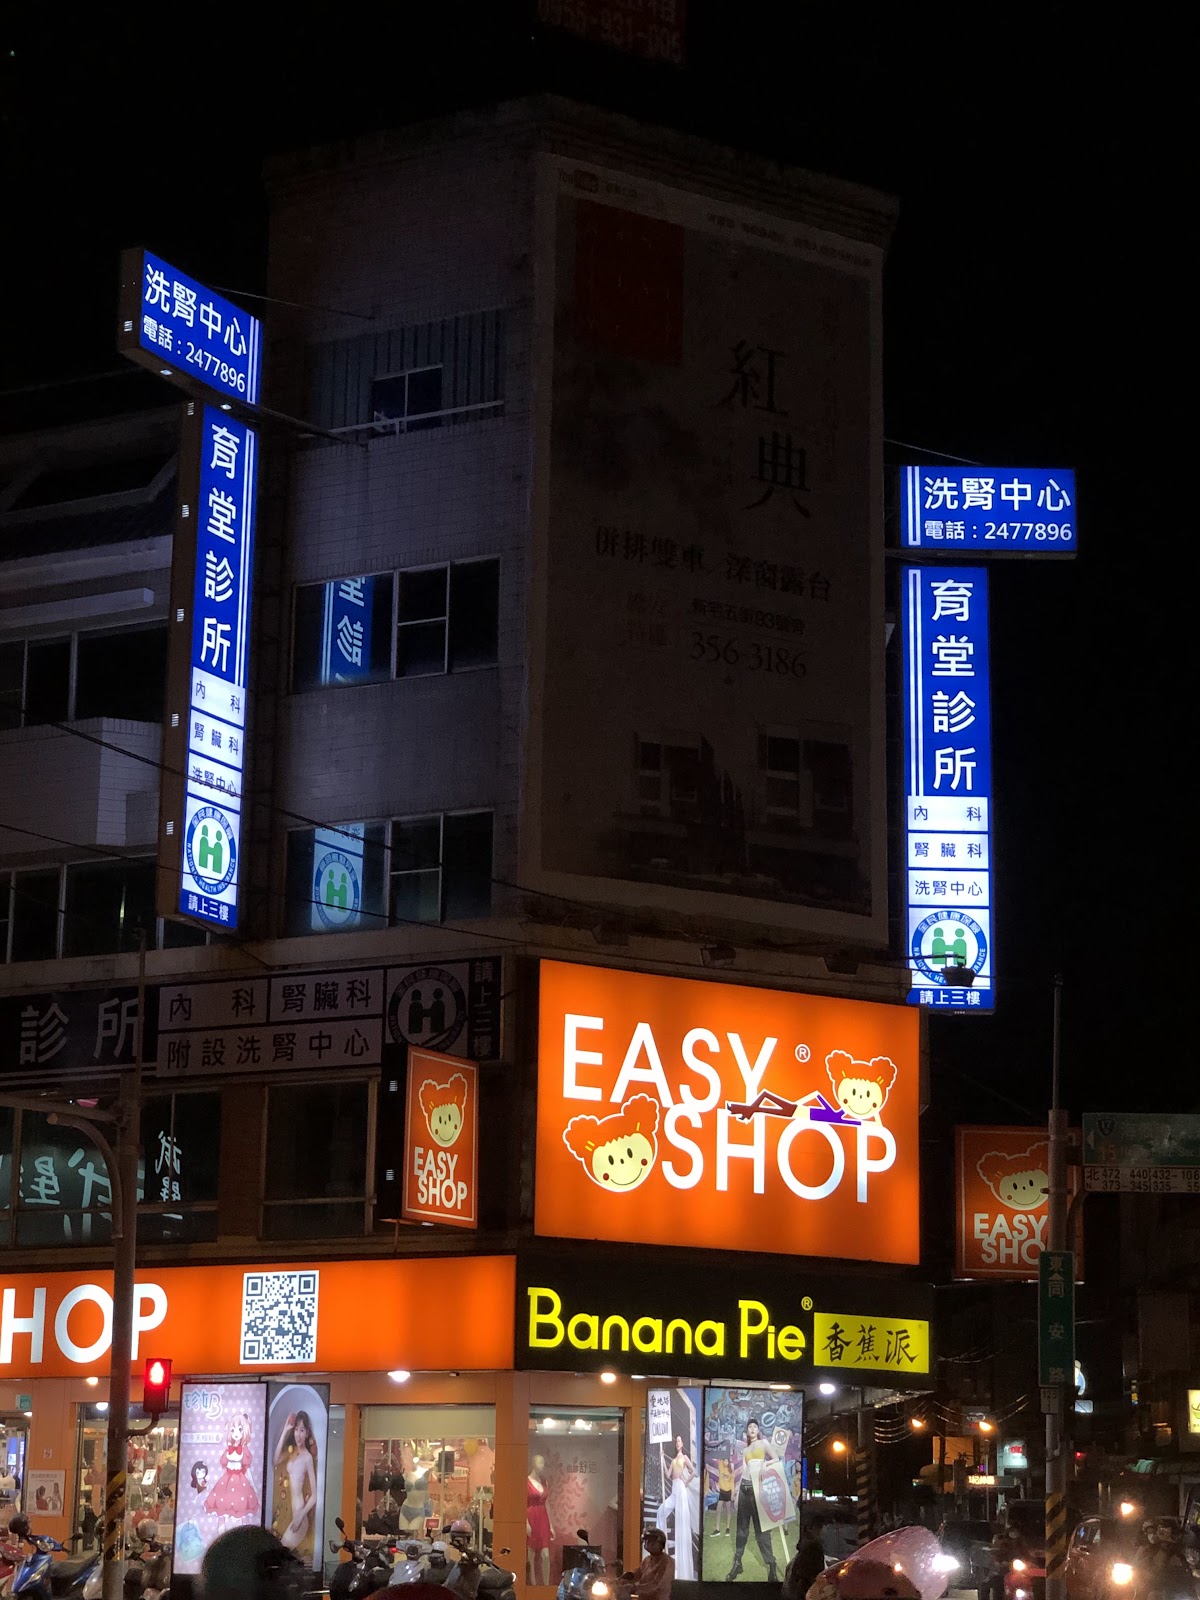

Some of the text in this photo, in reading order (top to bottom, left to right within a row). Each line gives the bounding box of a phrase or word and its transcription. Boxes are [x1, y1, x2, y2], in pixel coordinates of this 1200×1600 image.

[145, 263, 247, 357] 洗腎中心
[924, 477, 1071, 511] 洗腎中心
[201, 423, 240, 673] 育堂診所
[195, 680, 241, 714] 內科
[930, 579, 976, 790] 育堂診所
[194, 722, 239, 756] 腎臟科
[913, 806, 981, 822] 內科
[914, 842, 982, 859] 腎臟科
[914, 880, 983, 897] 洗腎中心
[188, 894, 229, 922] 請上三樓
[170, 988, 255, 1022] 內科
[282, 978, 372, 1012] 腎臟科
[920, 990, 980, 1005] 請上三樓
[20, 997, 139, 1065] 診所
[167, 1028, 370, 1069] 附設洗腎中心
[563, 1013, 778, 1113] EASY
[413, 1146, 459, 1182] EASY
[661, 1103, 897, 1203] SHOP
[1086, 1168, 1099, 1180] 北
[417, 1173, 468, 1210] SHOP
[973, 1213, 1048, 1241] EASY
[981, 1238, 1048, 1265] SHO
[527, 1286, 806, 1361] Banana Pie
[822, 1321, 920, 1366] 香蕉派
